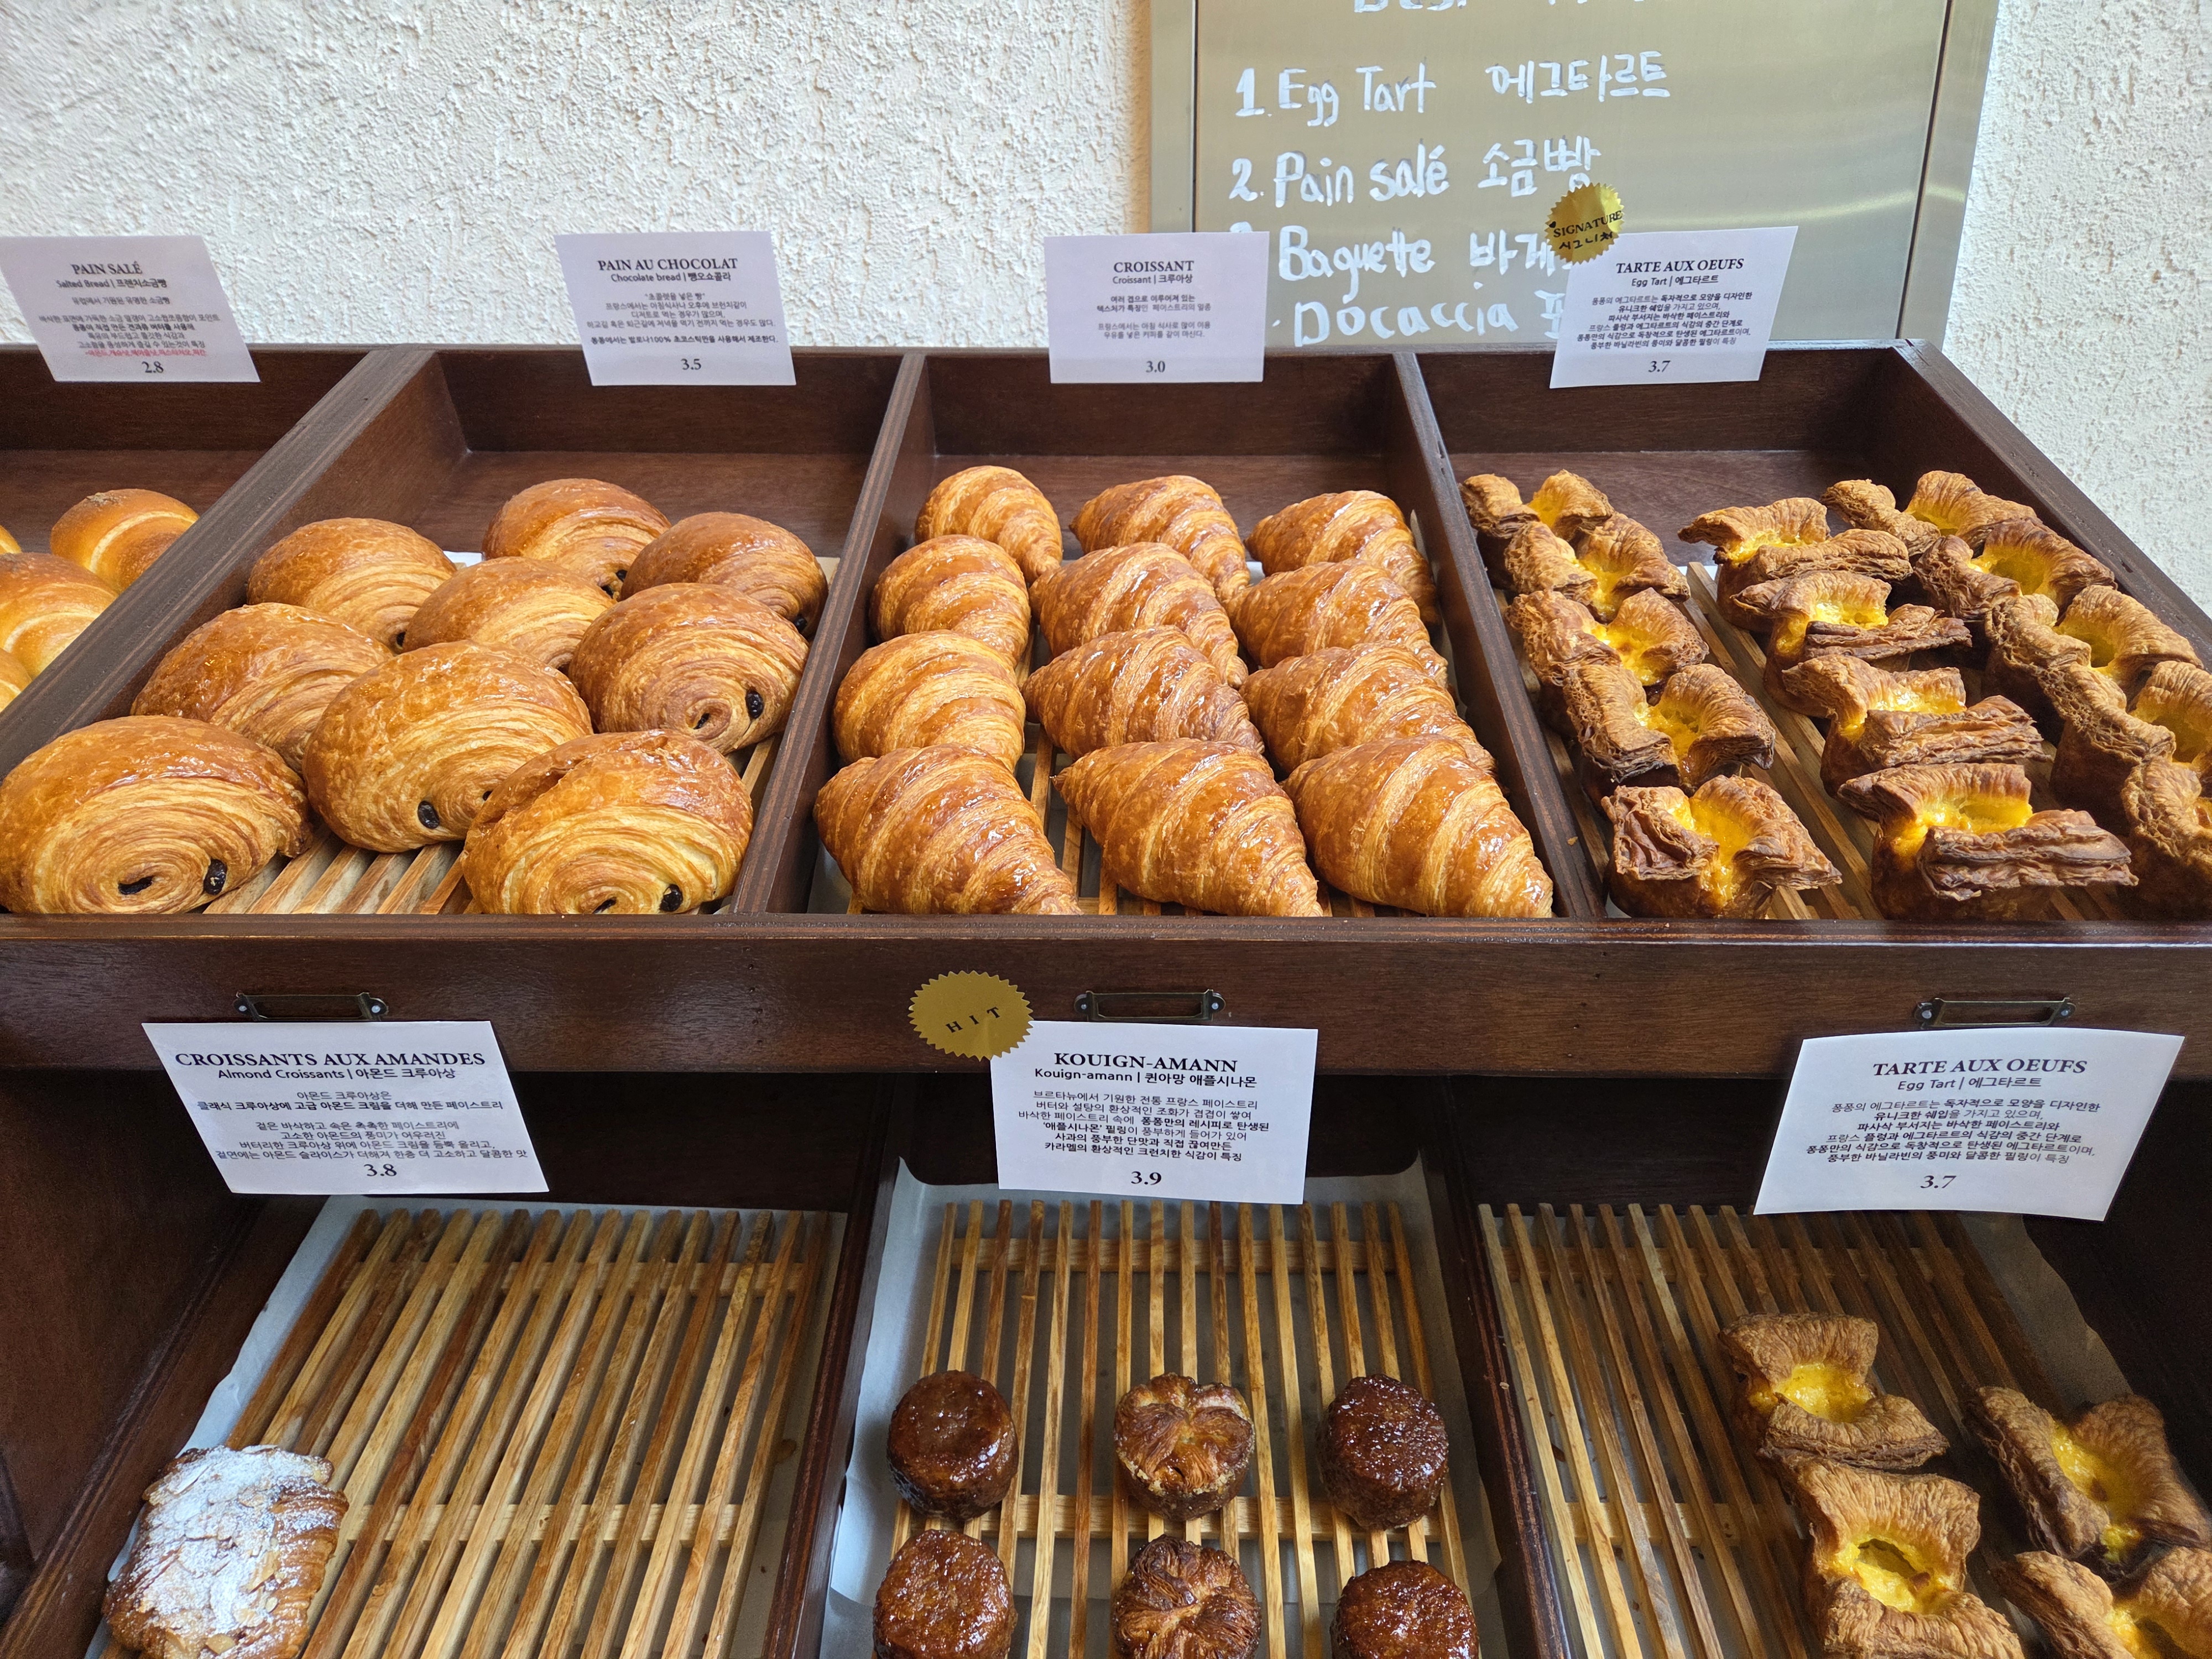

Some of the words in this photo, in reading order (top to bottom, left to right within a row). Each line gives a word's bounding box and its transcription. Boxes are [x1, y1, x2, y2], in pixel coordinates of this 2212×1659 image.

[1279, 67, 1339, 127] Egg
[1355, 62, 1437, 113] Tart
[1484, 51, 1671, 103] 에그타르트
[1274, 152, 1354, 208] Pain
[1369, 143, 1450, 202] salé
[1478, 135, 1601, 197] 소금빵
[1553, 210, 1623, 238] SIGNATURE
[1559, 231, 1613, 250] 시그니처
[1469, 229, 1572, 277] 바게
[70, 263, 107, 275] PAIN
[107, 261, 143, 275] SALÉ
[597, 259, 632, 271] PAIN
[635, 259, 654, 270] AU
[657, 258, 738, 270] CHOCOLAT
[1113, 260, 1194, 273] CROISSANT
[1616, 261, 1661, 274] TARTE
[1663, 260, 1695, 272] AUX
[1697, 258, 1744, 270] OEUFS
[55, 279, 84, 288] Salted
[83, 279, 111, 288] Bread
[611, 273, 654, 282] Chocolate
[655, 272, 681, 281] bread
[1112, 275, 1151, 284] Croissant
[1158, 274, 1193, 284] 크루아상
[1631, 278, 1648, 288] Egg
[1651, 277, 1667, 285] Tart
[1674, 274, 1719, 285] 에그타르트
[141, 361, 164, 373] 2.8
[681, 358, 702, 370] 3.5
[1146, 361, 1165, 373] 3.0
[1648, 360, 1671, 373] 3.7
[945, 1006, 1001, 1034] HIT
[175, 1053, 317, 1066] CROISSANTS
[324, 1053, 371, 1066] AUX
[374, 1053, 485, 1065] AMANDES
[1054, 1052, 1238, 1072] KOUIGN-AMANN
[218, 1069, 272, 1078] Almond
[275, 1069, 345, 1078] Croissants
[355, 1068, 398, 1079] 아몬드
[401, 1068, 456, 1079] 크루아상
[1872, 1060, 1947, 1076] TARTE
[1949, 1058, 2003, 1072] AUX
[2006, 1058, 2087, 1073] OEUFS
[1035, 1068, 1132, 1081] Kouign-amann
[1145, 1072, 1186, 1084] 퀸아망
[1190, 1074, 1257, 1088] 애플시나몬
[1897, 1081, 1924, 1092] Egg
[1930, 1079, 1956, 1088] Tart
[1968, 1077, 2042, 1088] 에그타르트
[296, 1091, 332, 1100] 아몬드
[335, 1091, 392, 1100] 크루아상은
[1033, 1091, 1098, 1102] 브르타뉴에서
[1103, 1093, 1136, 1104] 기원한
[1140, 1095, 1162, 1105] 전통
[1165, 1097, 1199, 1107] 프랑스
[1202, 1099, 1258, 1110] 페이스트리
[197, 1102, 232, 1110] 클래식
[234, 1102, 292, 1110] 크루아상에
[294, 1101, 317, 1110] 고급
[320, 1101, 356, 1110] 아몬드
[357, 1101, 392, 1110] 크림을
[394, 1101, 419, 1110] 더해
[420, 1100, 444, 1110] 만든
[445, 1100, 503, 1110] 페이스트리
[1036, 1101, 1069, 1110] 버터와
[1072, 1102, 1104, 1113] 설탕의
[1108, 1104, 1152, 1115] 환상적인
[1156, 1107, 1190, 1118] 조화가
[1193, 1109, 1225, 1119] 겹겹이
[1229, 1110, 1251, 1120] 쌓여
[1870, 1100, 1940, 1111] 에그타르트는
[1943, 1098, 2004, 1108] 독자적으로
[2006, 1099, 2046, 1109] 모양을
[2049, 1100, 2101, 1113] 디자인한
[1018, 1110, 1051, 1120] 바삭한
[1054, 1112, 1108, 1123] 페이스트리
[1113, 1115, 1134, 1125] 속에
[1189, 1119, 1233, 1130] 레시피로
[1237, 1121, 1269, 1131] 탄생된
[1874, 1110, 1922, 1121] 유니크한
[1963, 1109, 2000, 1118] 가지고
[280, 1121, 327, 1130] 바삭하고
[390, 1121, 460, 1130] 페이스트리에
[1856, 1121, 1893, 1131] 파사삭
[1895, 1120, 1943, 1130] 부서지는
[1946, 1120, 1983, 1129] 바삭한
[1985, 1120, 2060, 1131] 페이스트리와
[280, 1131, 314, 1140] 고소한
[316, 1131, 362, 1140] 아몬드의
[401, 1131, 446, 1140] 어우러진
[1105, 1125, 1138, 1135] 필링이
[1141, 1126, 1185, 1138] 풍부하게
[1189, 1129, 1222, 1140] 들어가
[1225, 1131, 1246, 1141] 있어
[1825, 1134, 1860, 1142] 프랑스
[1902, 1130, 1973, 1140] 에그타르트의
[1976, 1130, 2013, 1140] 식감의
[2016, 1131, 2042, 1141] 중간
[2045, 1133, 2081, 1143] 단계로
[239, 1141, 285, 1150] 버터리한
[286, 1141, 331, 1150] 크루아상
[334, 1141, 358, 1150] 위에
[359, 1140, 394, 1150] 아몬드
[397, 1140, 430, 1149] 크림을
[1055, 1132, 1087, 1142] 사과의
[1091, 1134, 1124, 1145] 풍부한
[1127, 1136, 1160, 1147] 단맛과
[1163, 1139, 1184, 1149] 직접
[1855, 1140, 1901, 1151] 식감으로
[1904, 1141, 1963, 1150] 독창적으로
[1967, 1140, 2003, 1150] 탄생된
[262, 1150, 297, 1160] 아몬드
[298, 1150, 354, 1159] 슬라이스가
[418, 1150, 430, 1159] 더
[433, 1150, 477, 1158] 고소하고
[479, 1149, 513, 1159] 달콤한
[515, 1149, 528, 1158] 맛
[1045, 1142, 1087, 1152] 카라멜의
[1091, 1144, 1133, 1155] 환상적인
[1137, 1147, 1182, 1159] 크런치한
[1185, 1150, 1217, 1160] 식감이
[1220, 1152, 1241, 1161] 특징
[1827, 1152, 1862, 1162] 풍부한
[1865, 1151, 1923, 1161] 바닐라빈의
[1926, 1151, 1961, 1160] 풍미와
[1965, 1151, 2001, 1160] 달콤한
[2004, 1152, 2041, 1162] 필링이
[2044, 1154, 2069, 1164] 특징
[363, 1164, 397, 1177] 3.8
[1131, 1171, 1162, 1185] 3.9
[1920, 1175, 1957, 1188] 3.7
